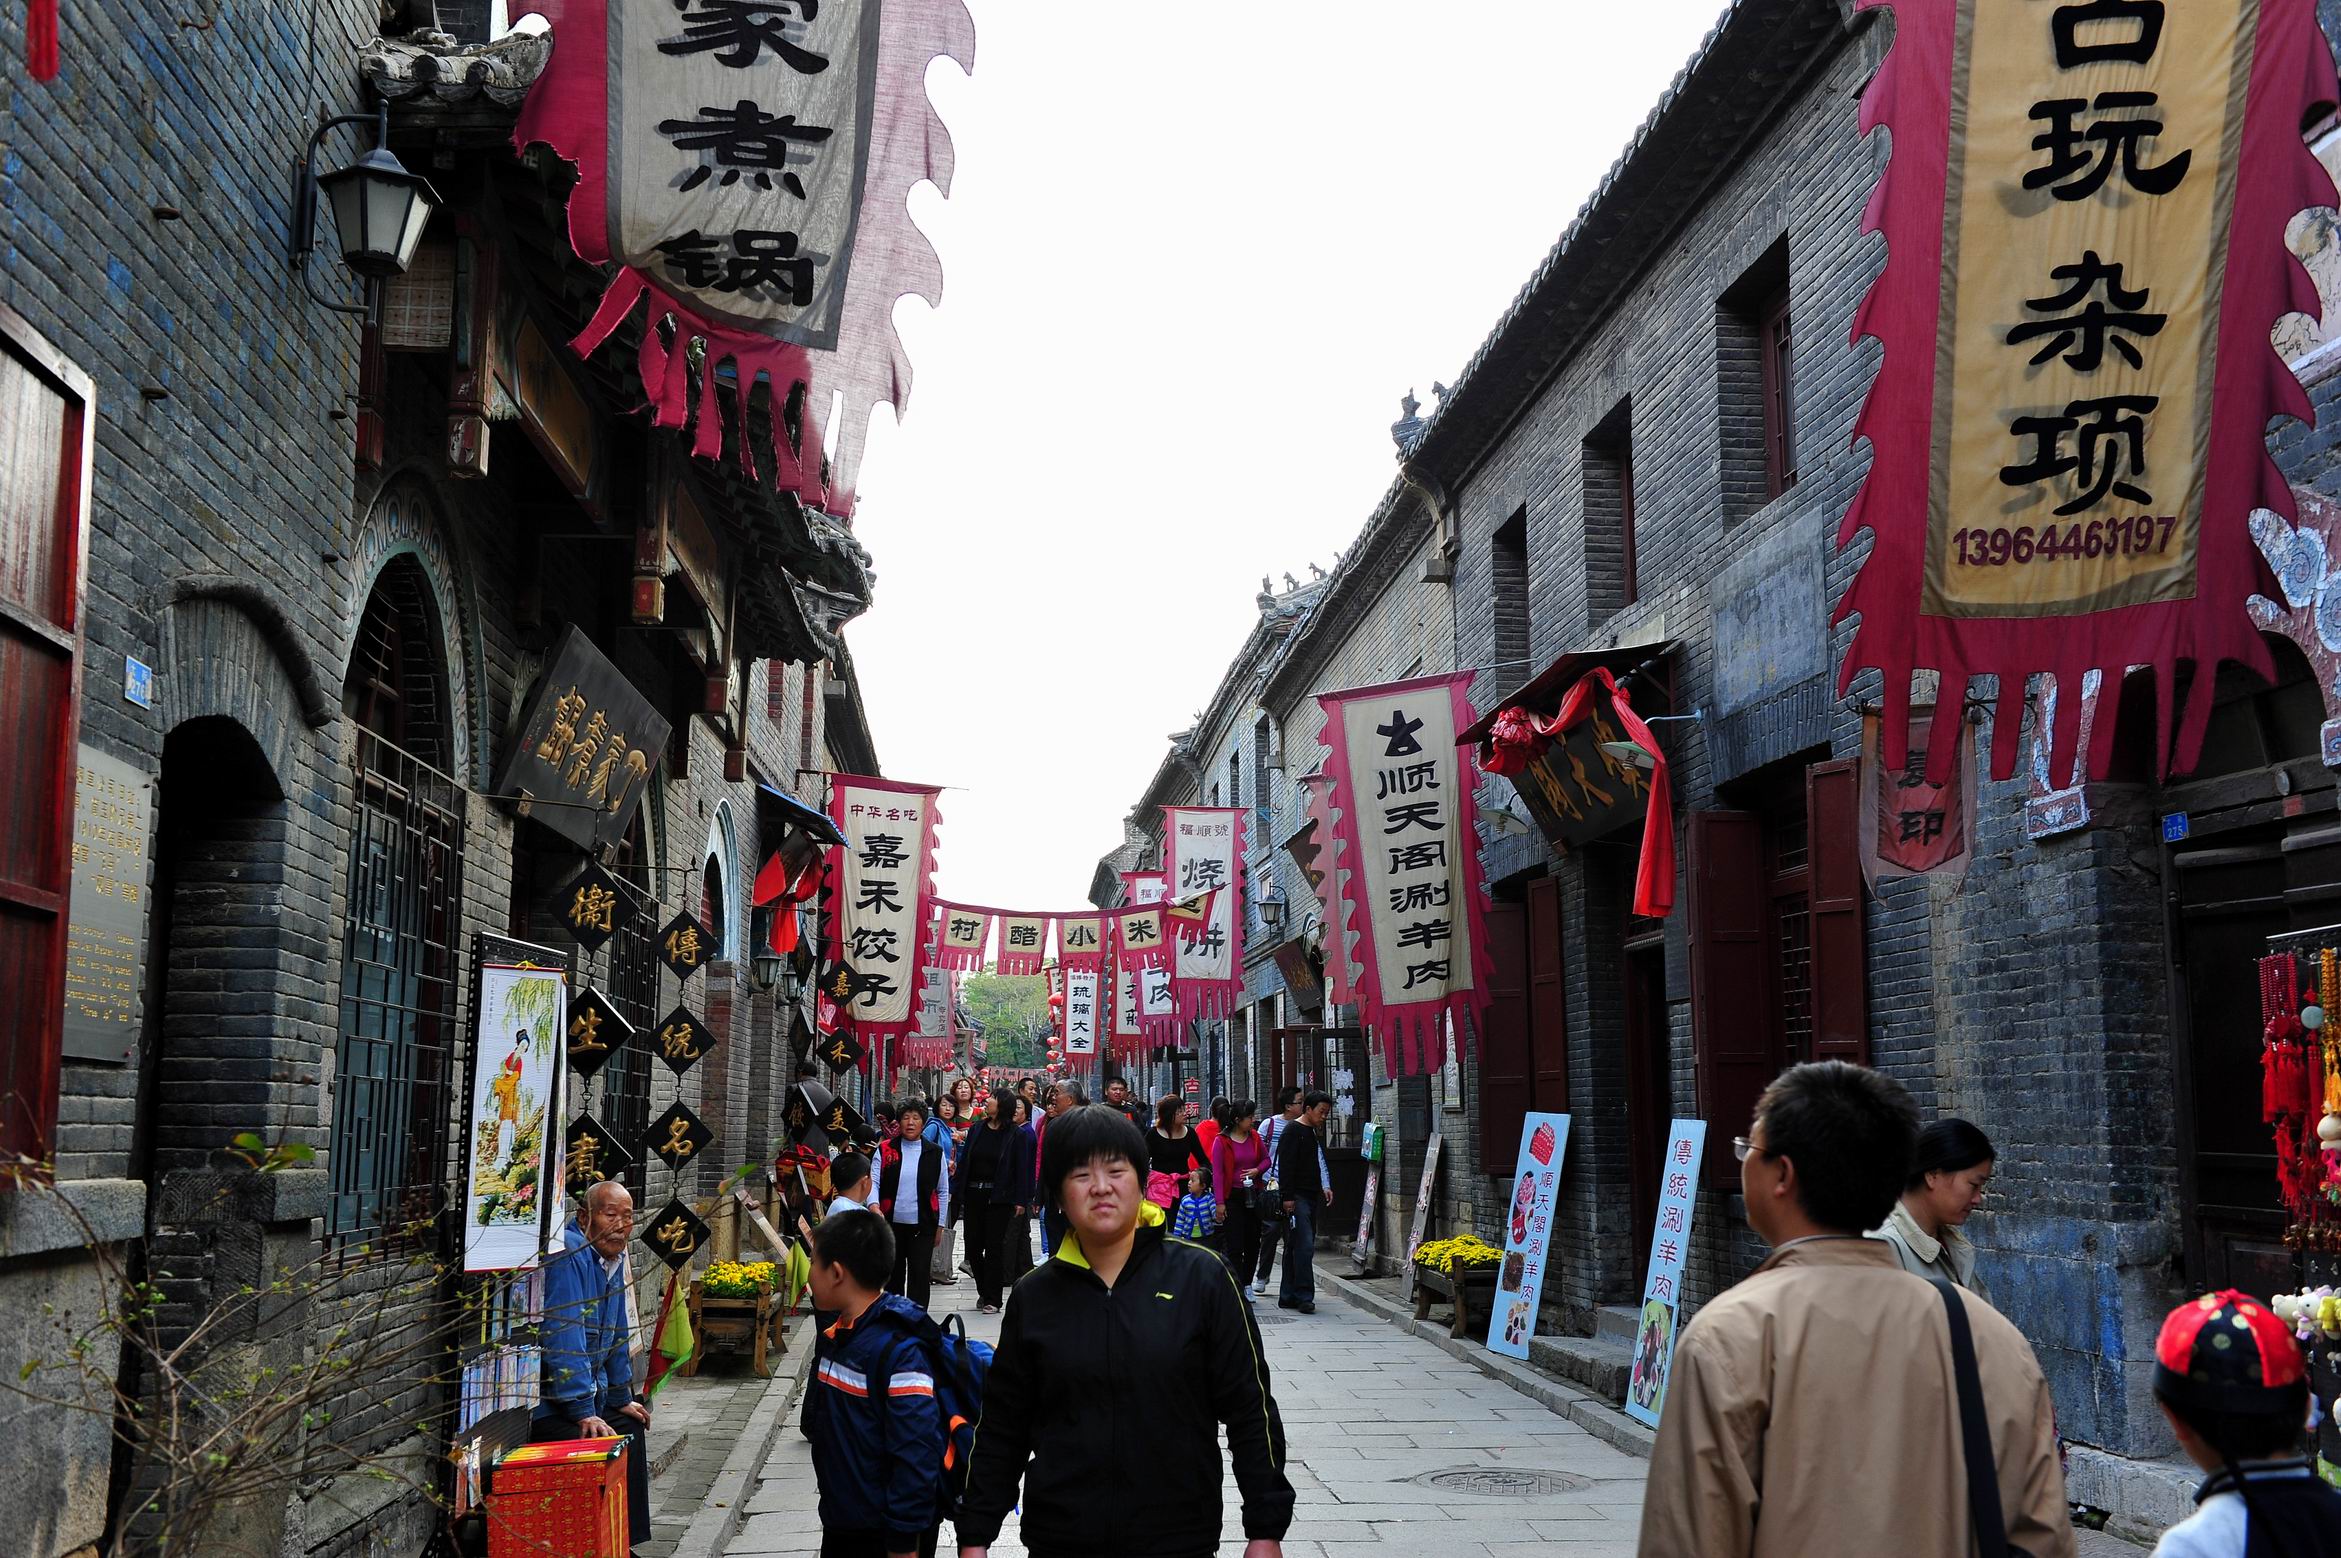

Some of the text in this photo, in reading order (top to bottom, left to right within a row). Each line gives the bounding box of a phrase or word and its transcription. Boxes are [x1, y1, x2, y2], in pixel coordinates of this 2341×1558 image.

[657, 0, 833, 307] 家煮锅
[1952, 515, 2177, 567] 13964463197
[850, 804, 918, 821] 中华名吃
[852, 833, 910, 1008] 嘉禾饺子
[1071, 986, 1092, 1049] 琉璃大全
[1520, 1171, 1555, 1302] 順天閣涮羊肉
[1651, 1138, 1694, 1302] 傳統涮羊肉
